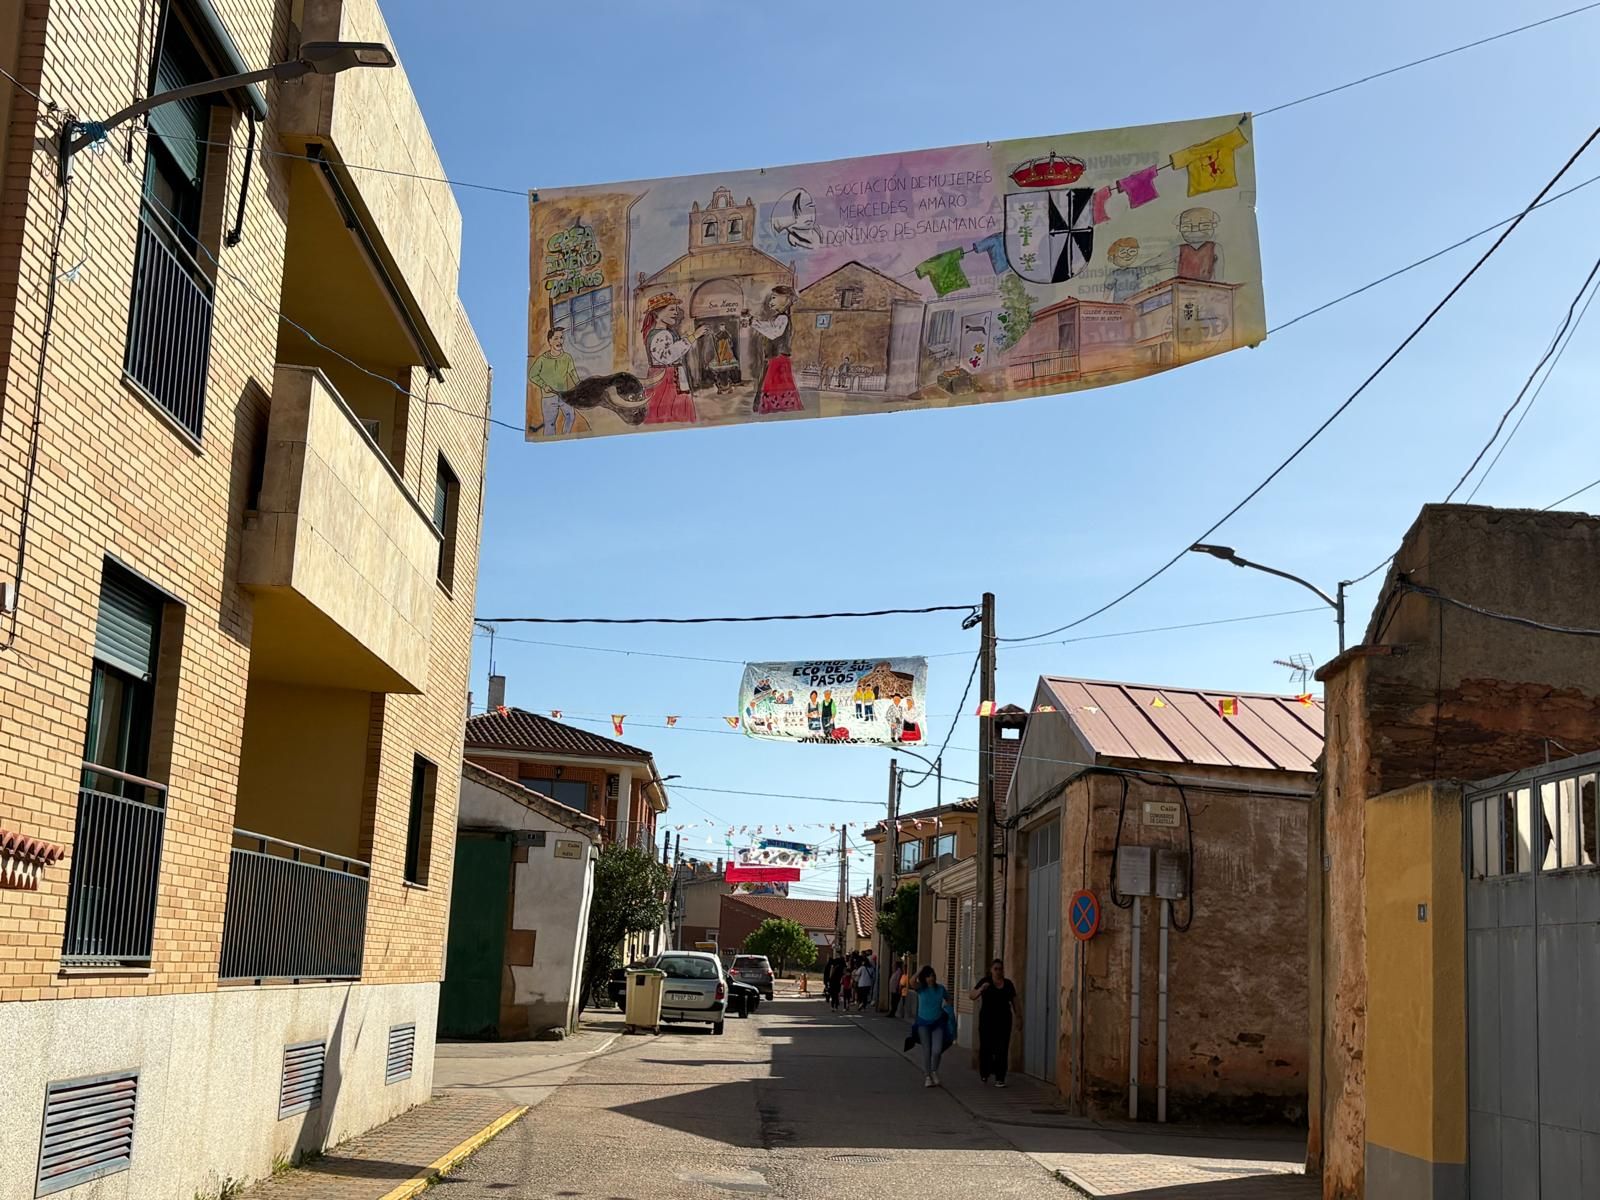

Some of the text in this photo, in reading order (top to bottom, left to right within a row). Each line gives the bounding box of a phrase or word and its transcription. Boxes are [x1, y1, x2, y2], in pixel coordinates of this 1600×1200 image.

[825, 169, 993, 197] ASOCIACIÓN DE MUJERES
[839, 194, 967, 219] MERCEDES AMARO
[826, 224, 888, 245] DOÑINOS
[895, 222, 912, 237] DE
[916, 215, 996, 234] SALAMANCA
[792, 664, 873, 677] ECO DE SUS
[810, 673, 854, 687] PASOS
